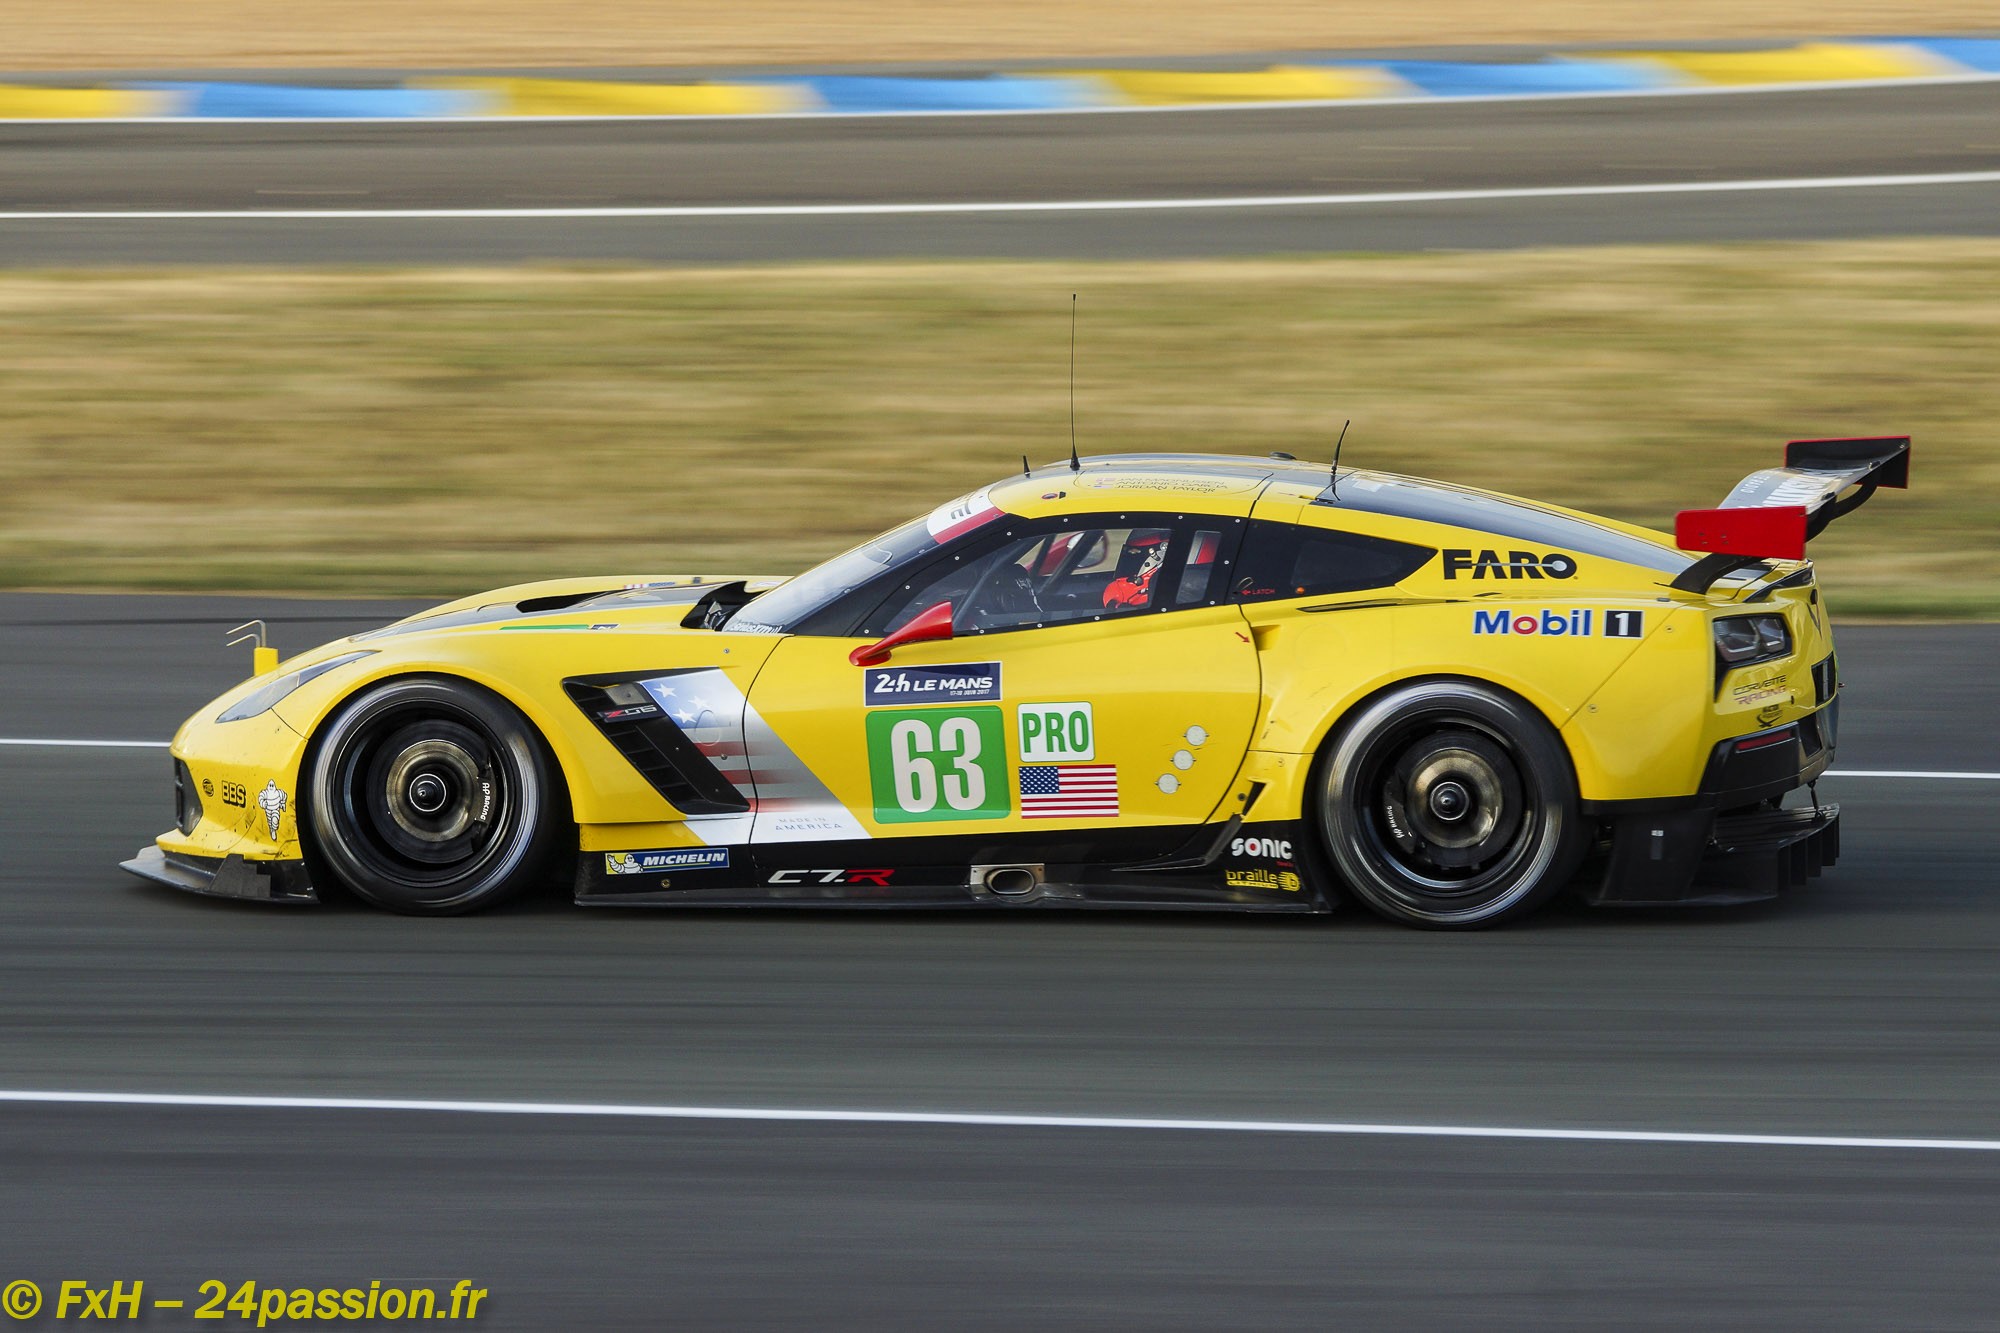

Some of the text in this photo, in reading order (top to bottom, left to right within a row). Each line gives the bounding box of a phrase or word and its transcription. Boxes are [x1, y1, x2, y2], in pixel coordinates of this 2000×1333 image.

[1172, 486, 1216, 494] TAYLOR
[1442, 548, 1577, 580] FARO
[1473, 609, 1630, 636] Mobil 1
[913, 680, 938, 692] LE
[938, 677, 993, 691] MANS
[1022, 710, 1089, 754] PRO
[890, 717, 986, 813] 63
[221, 780, 247, 809] BBS
[775, 823, 843, 831] AMERICA
[643, 852, 726, 867] MICHELIN
